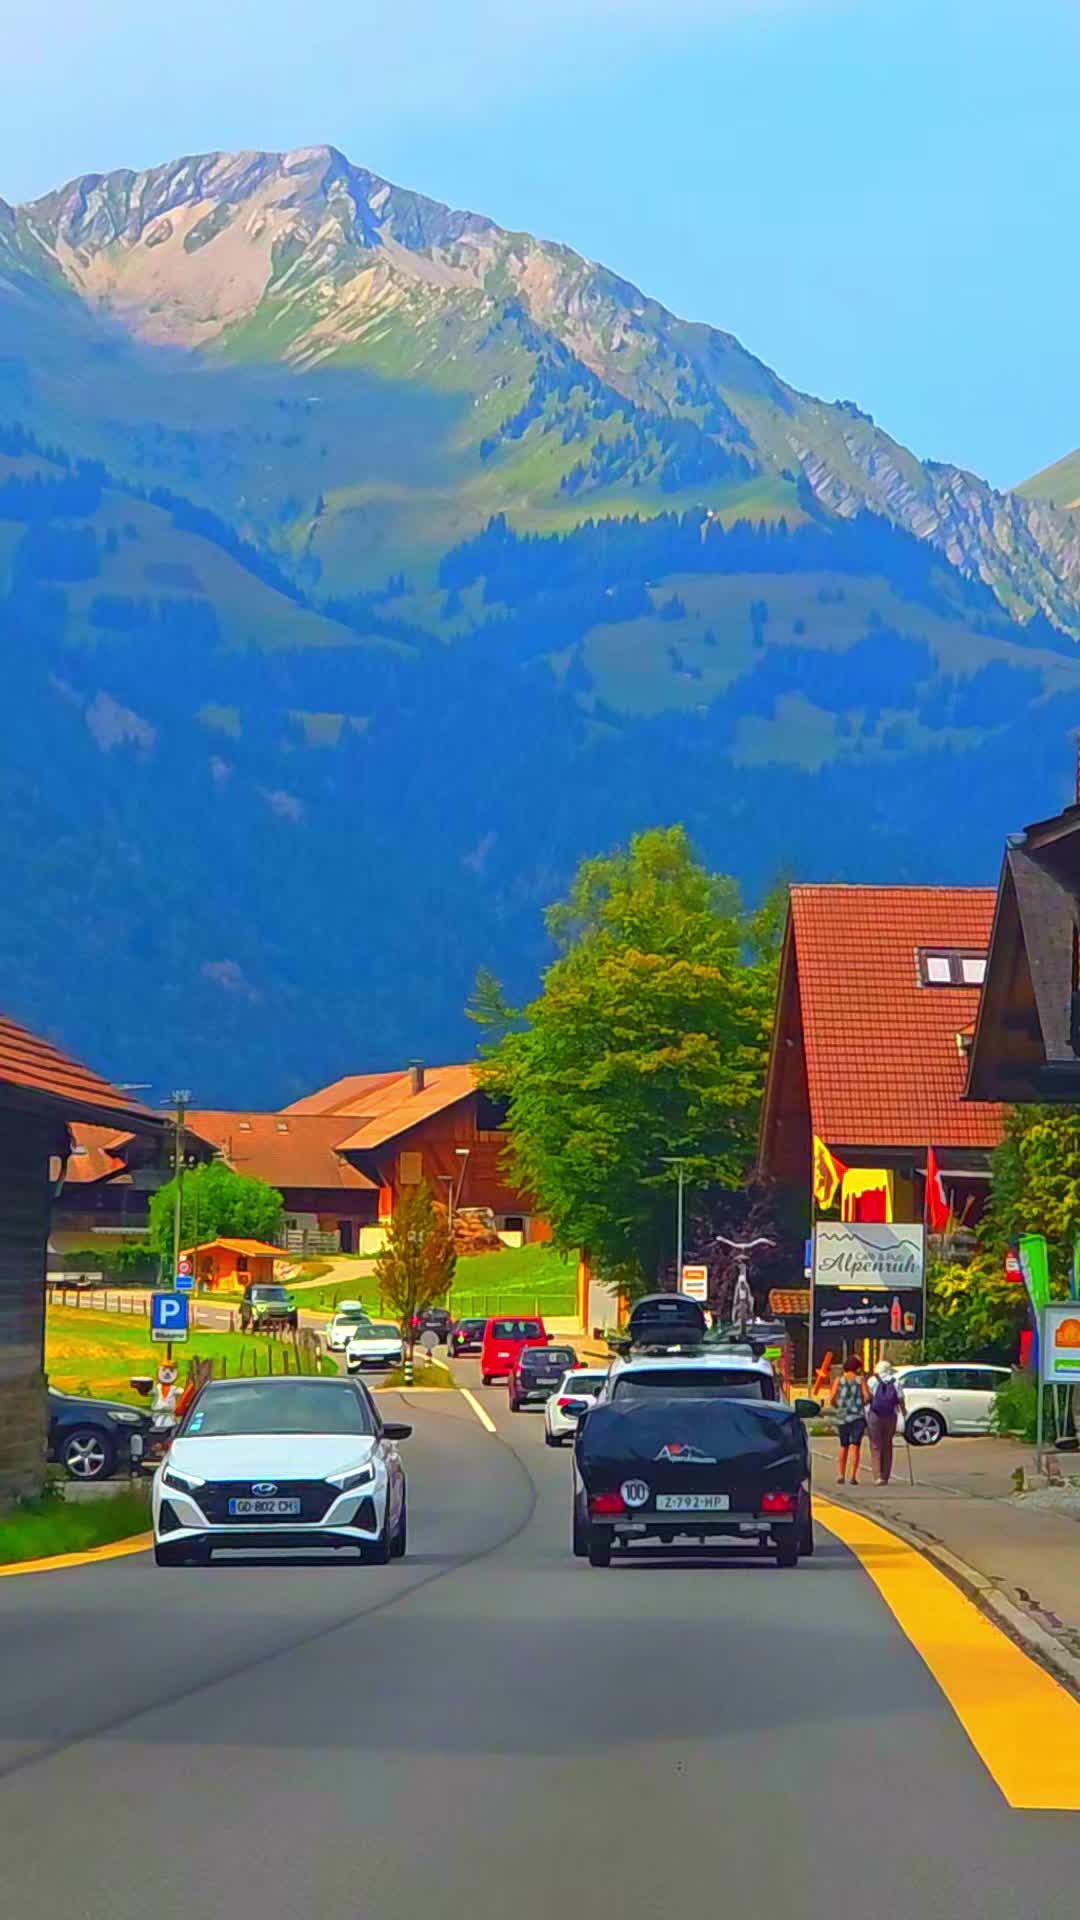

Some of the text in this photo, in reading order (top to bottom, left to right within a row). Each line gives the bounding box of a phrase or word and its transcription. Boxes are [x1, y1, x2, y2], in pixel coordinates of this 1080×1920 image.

[818, 1251, 918, 1279] Alpenruh
[160, 1299, 180, 1325] P
[624, 1483, 646, 1500] 100
